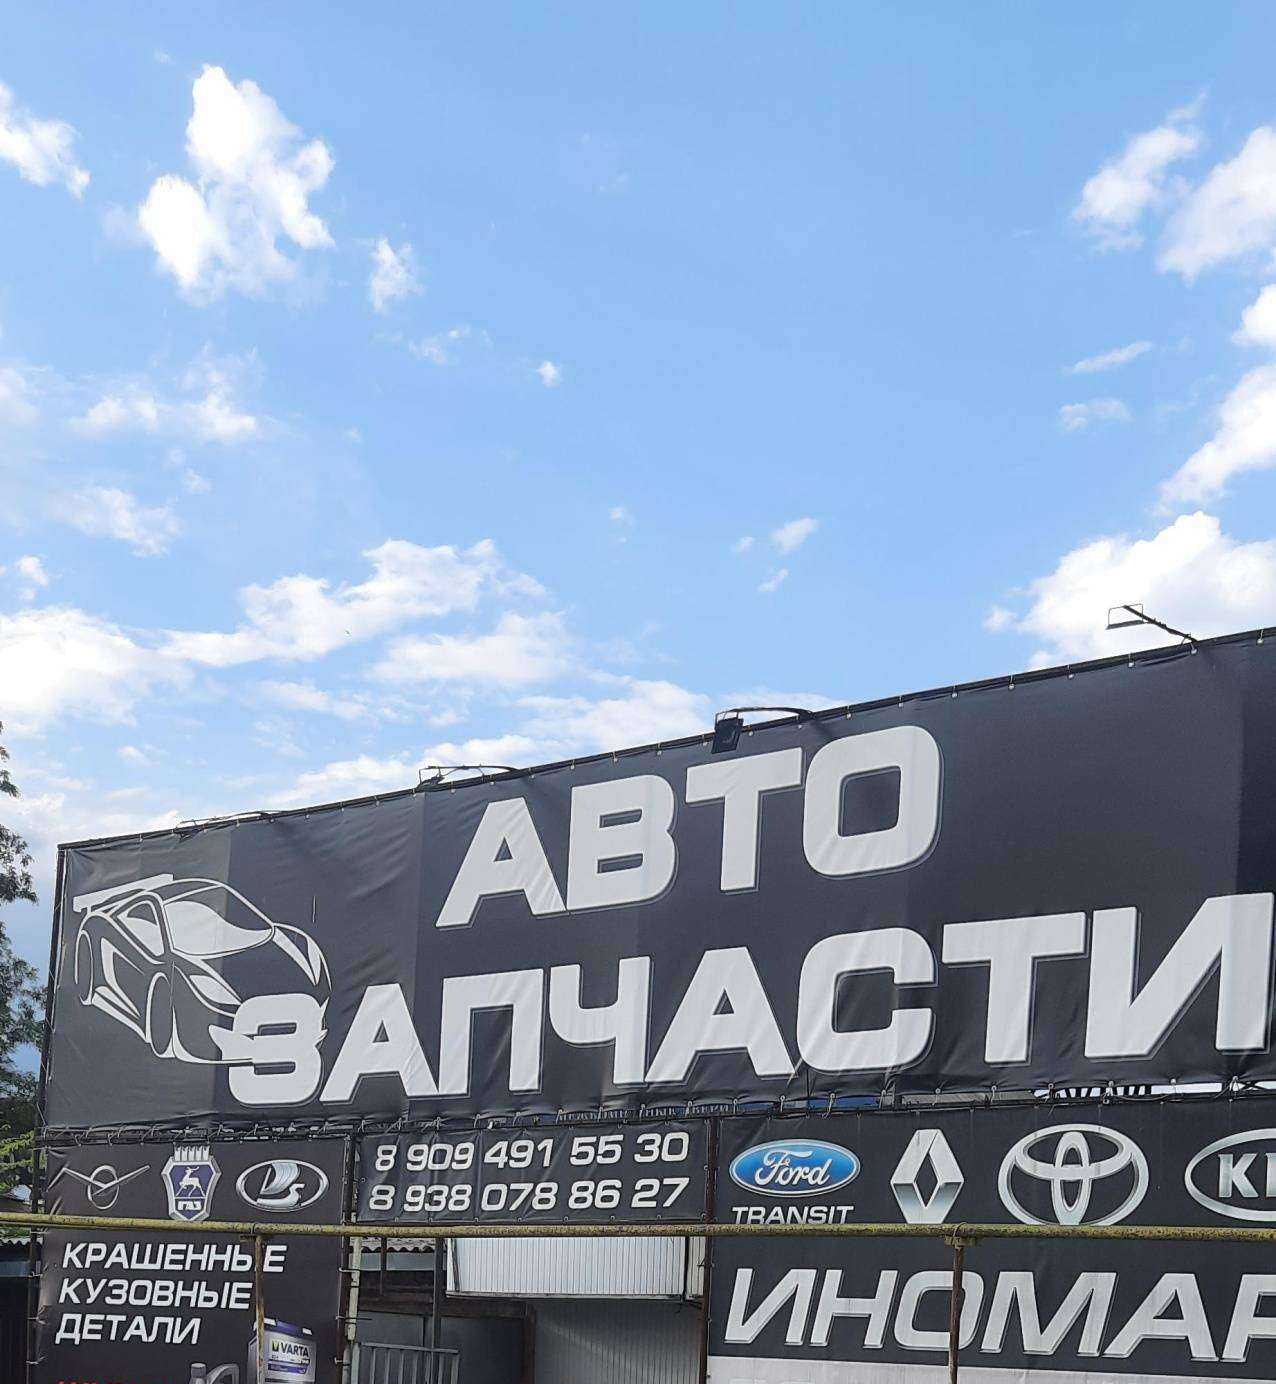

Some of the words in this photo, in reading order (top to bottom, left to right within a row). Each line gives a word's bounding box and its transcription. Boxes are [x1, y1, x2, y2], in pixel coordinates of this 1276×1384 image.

[435, 725, 942, 928] АВТО
[228, 892, 1274, 1107] ЗАПЧАСТИ
[375, 1144, 397, 1171] 8
[406, 1142, 475, 1171] 909
[484, 1138, 553, 1168] 491
[570, 1135, 624, 1165] 55
[634, 1132, 690, 1163] 30
[754, 1149, 833, 1186] Ford
[369, 1184, 395, 1210] 8
[403, 1184, 472, 1212] 938
[481, 1183, 558, 1211] 078
[568, 1180, 622, 1209] 86
[631, 1177, 690, 1208] 27
[732, 1205, 854, 1225] TRANSIT
[58, 1278, 253, 1310] КУЗОВНЫЕ
[54, 1313, 202, 1345] ДЕТАЛИ
[281, 1342, 309, 1358] VARTA
